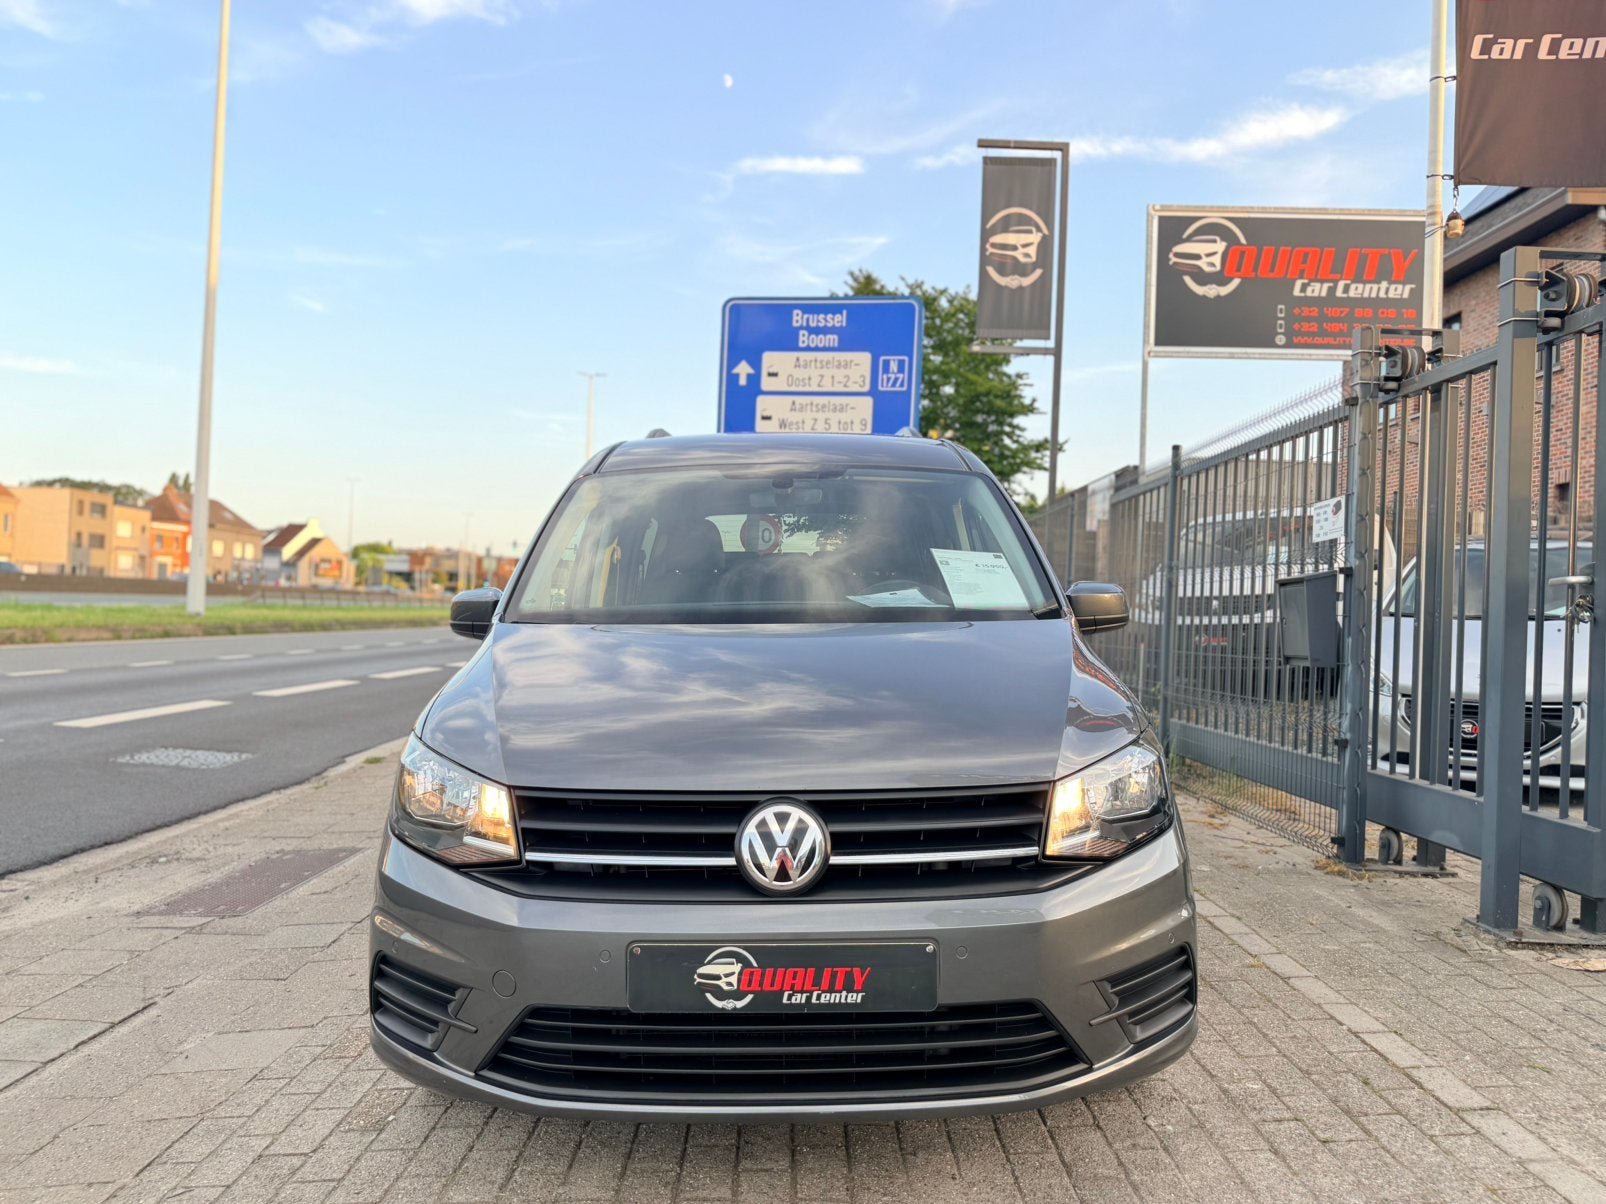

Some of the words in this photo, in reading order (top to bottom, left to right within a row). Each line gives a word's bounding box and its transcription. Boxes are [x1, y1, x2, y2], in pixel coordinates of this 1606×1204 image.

[1470, 33, 1534, 60] Car
[1537, 33, 1606, 60] Cen
[1223, 245, 1419, 281] QUALITY
[1292, 279, 1334, 297] Car
[1335, 280, 1416, 299] Center
[791, 309, 848, 328] Brussel
[1293, 306, 1319, 318] +32
[1293, 321, 1319, 333] +32
[798, 330, 839, 348] Boom
[793, 356, 861, 370] Aartselaar-
[889, 359, 898, 373] N
[786, 374, 812, 388] Oost
[817, 375, 824, 388] Z
[830, 374, 867, 388] 1-2-3
[882, 373, 904, 388] 177
[789, 400, 857, 413] Aartselaar-
[778, 418, 806, 431] West
[810, 418, 818, 431] Z
[824, 418, 831, 431] 5
[837, 418, 854, 431] tot
[859, 418, 868, 431] 9
[739, 967, 872, 992] QUALITY
[782, 990, 809, 1004] Car
[811, 990, 866, 1004] Center
